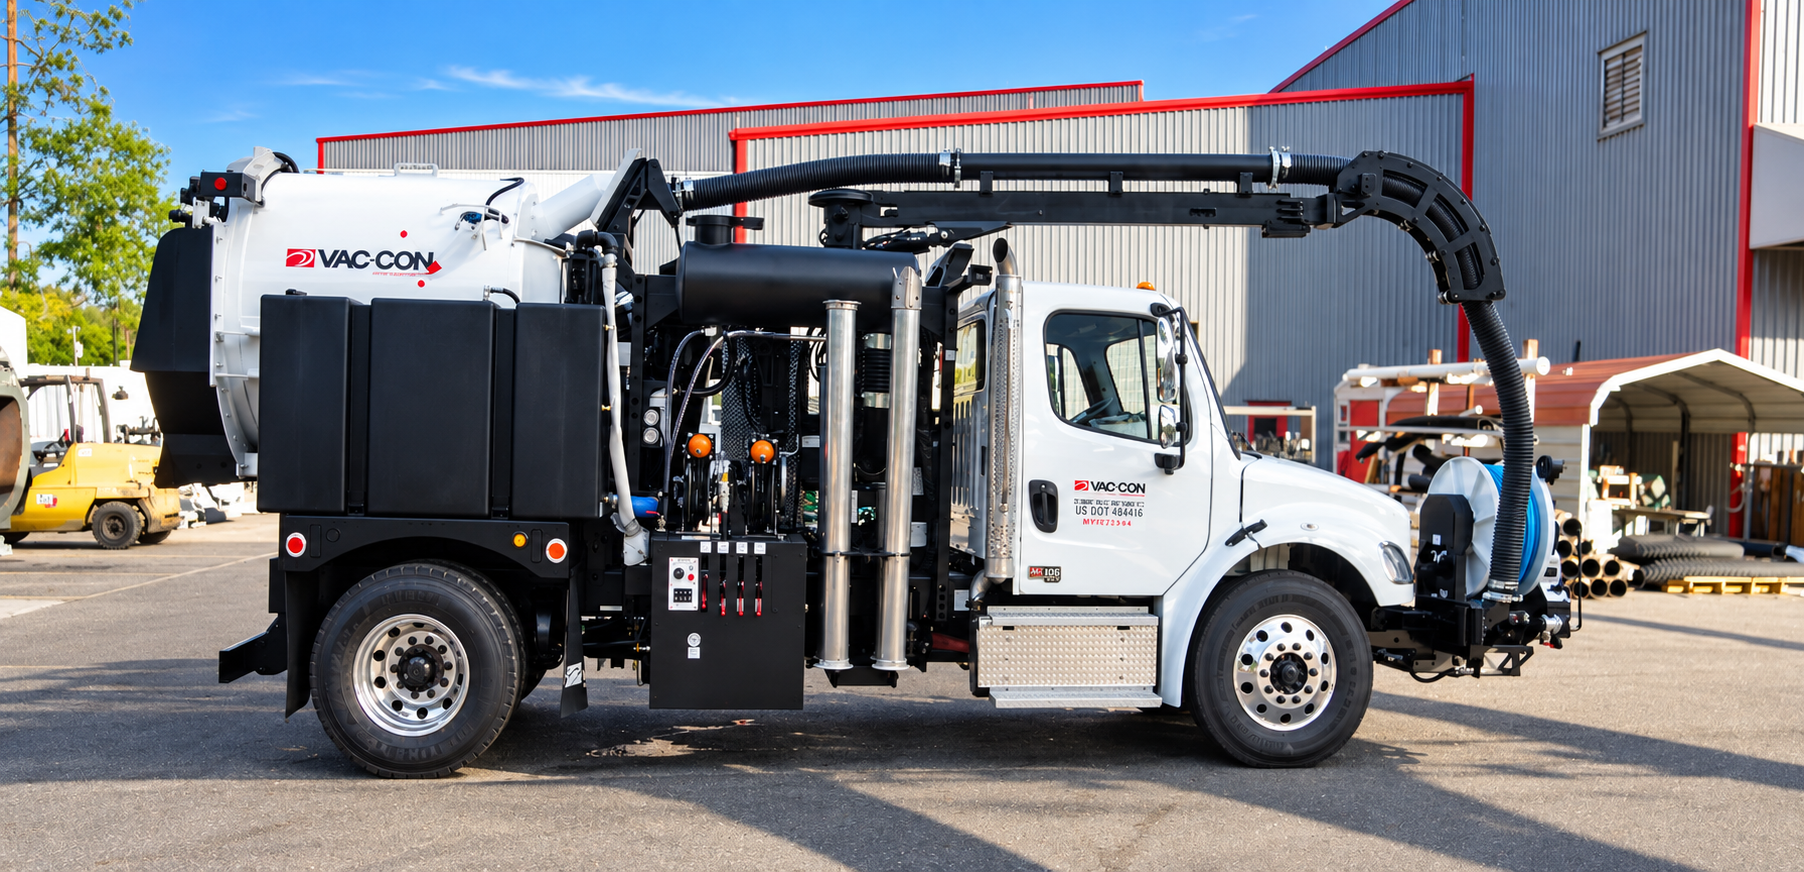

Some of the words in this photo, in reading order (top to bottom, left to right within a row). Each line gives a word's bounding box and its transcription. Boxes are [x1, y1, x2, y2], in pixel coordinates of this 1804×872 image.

[318, 249, 434, 271] VAC-CON
[1090, 481, 1146, 494] VAC-CON
[1075, 505, 1088, 516] US
[1090, 506, 1109, 516] DOT
[1112, 507, 1143, 518] 484416
[1044, 568, 1060, 576] 106
